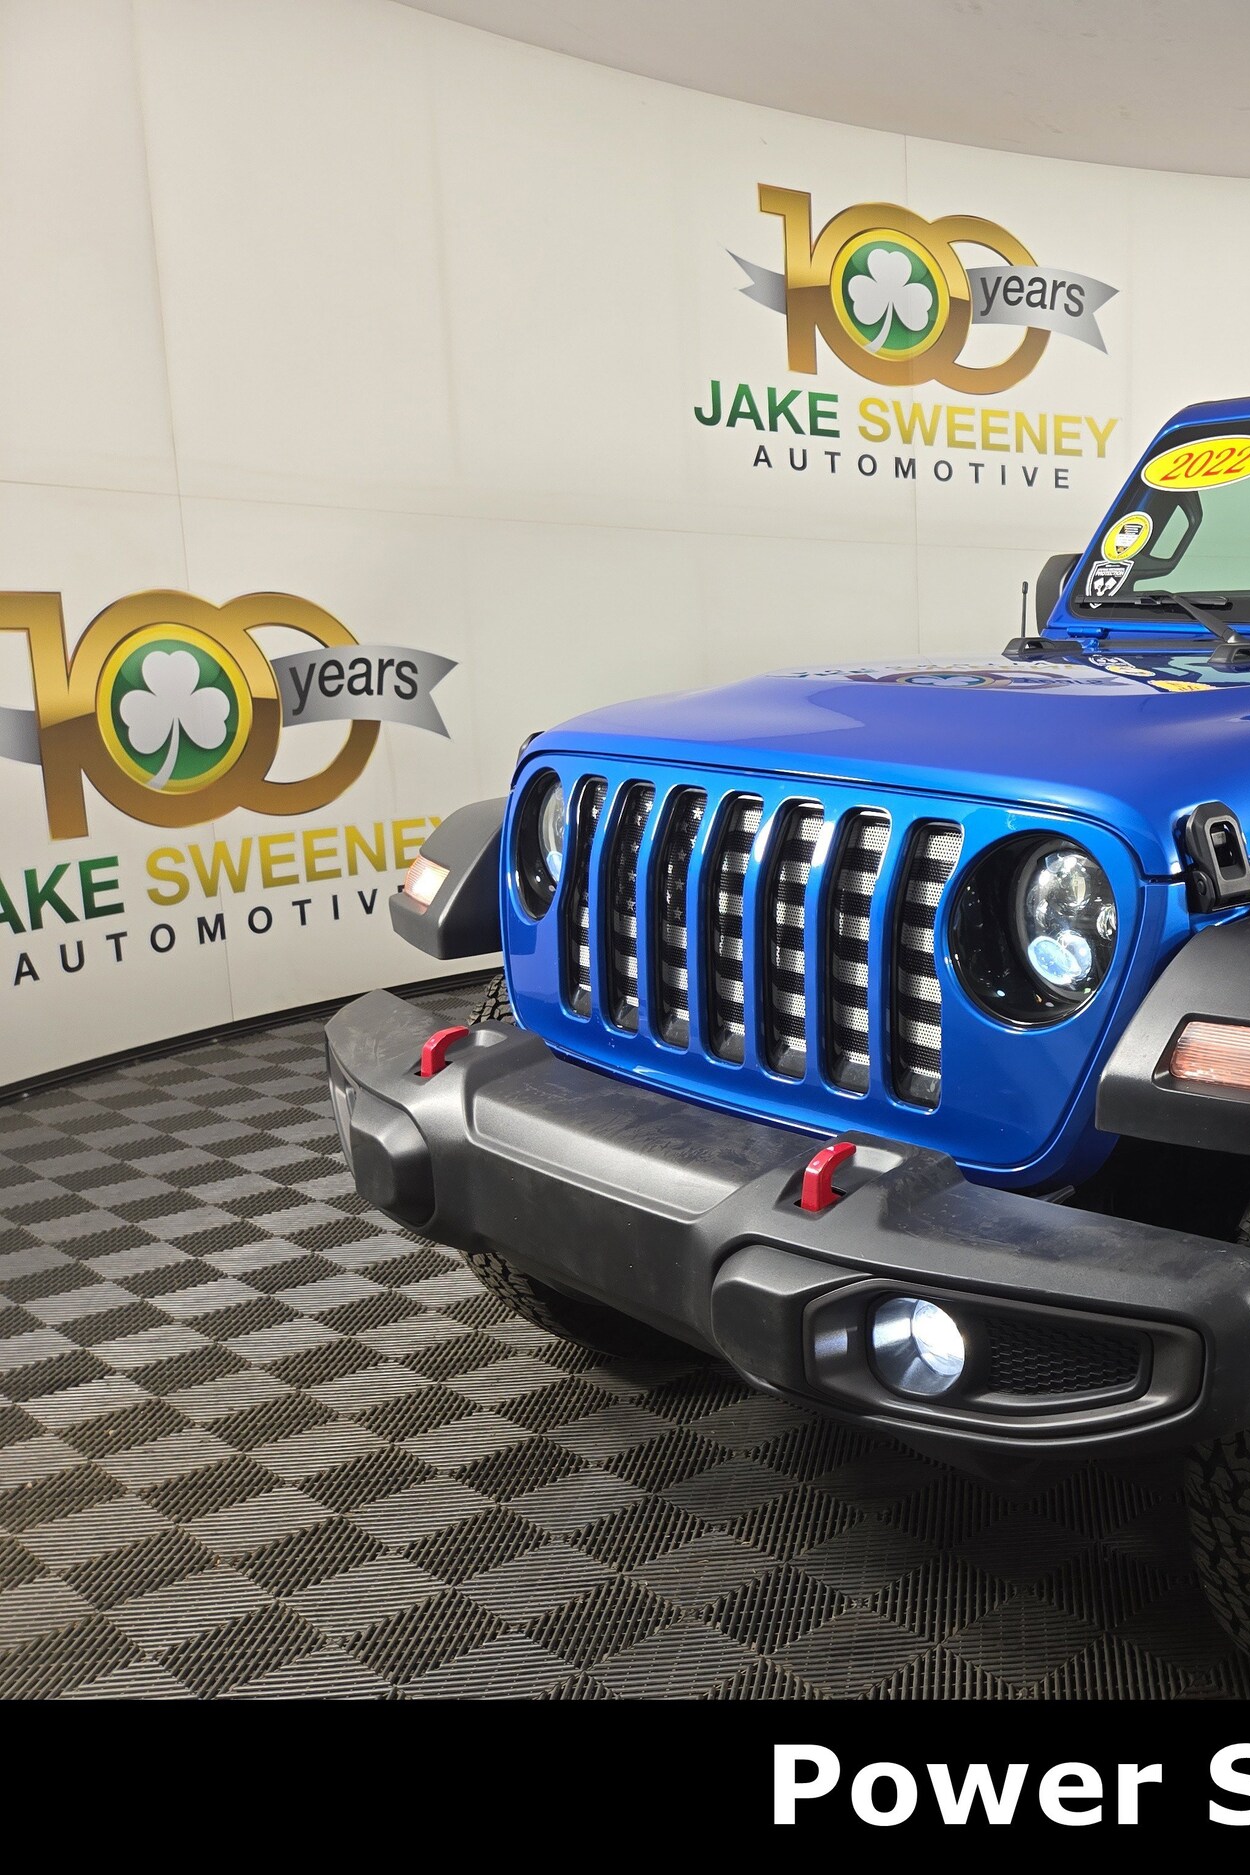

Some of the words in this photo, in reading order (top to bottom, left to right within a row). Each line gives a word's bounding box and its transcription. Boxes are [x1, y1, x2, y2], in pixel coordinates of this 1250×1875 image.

[757, 183, 1051, 395] 100
[979, 272, 1086, 318] years
[694, 379, 841, 438] JAKE
[857, 397, 1118, 459] SWEENEY
[753, 444, 1070, 489] AUTOMOTIVE
[289, 656, 419, 716] years
[0, 855, 125, 935] AKE
[145, 816, 442, 907] SWEENE
[13, 884, 406, 986] AUTOMOTIV
